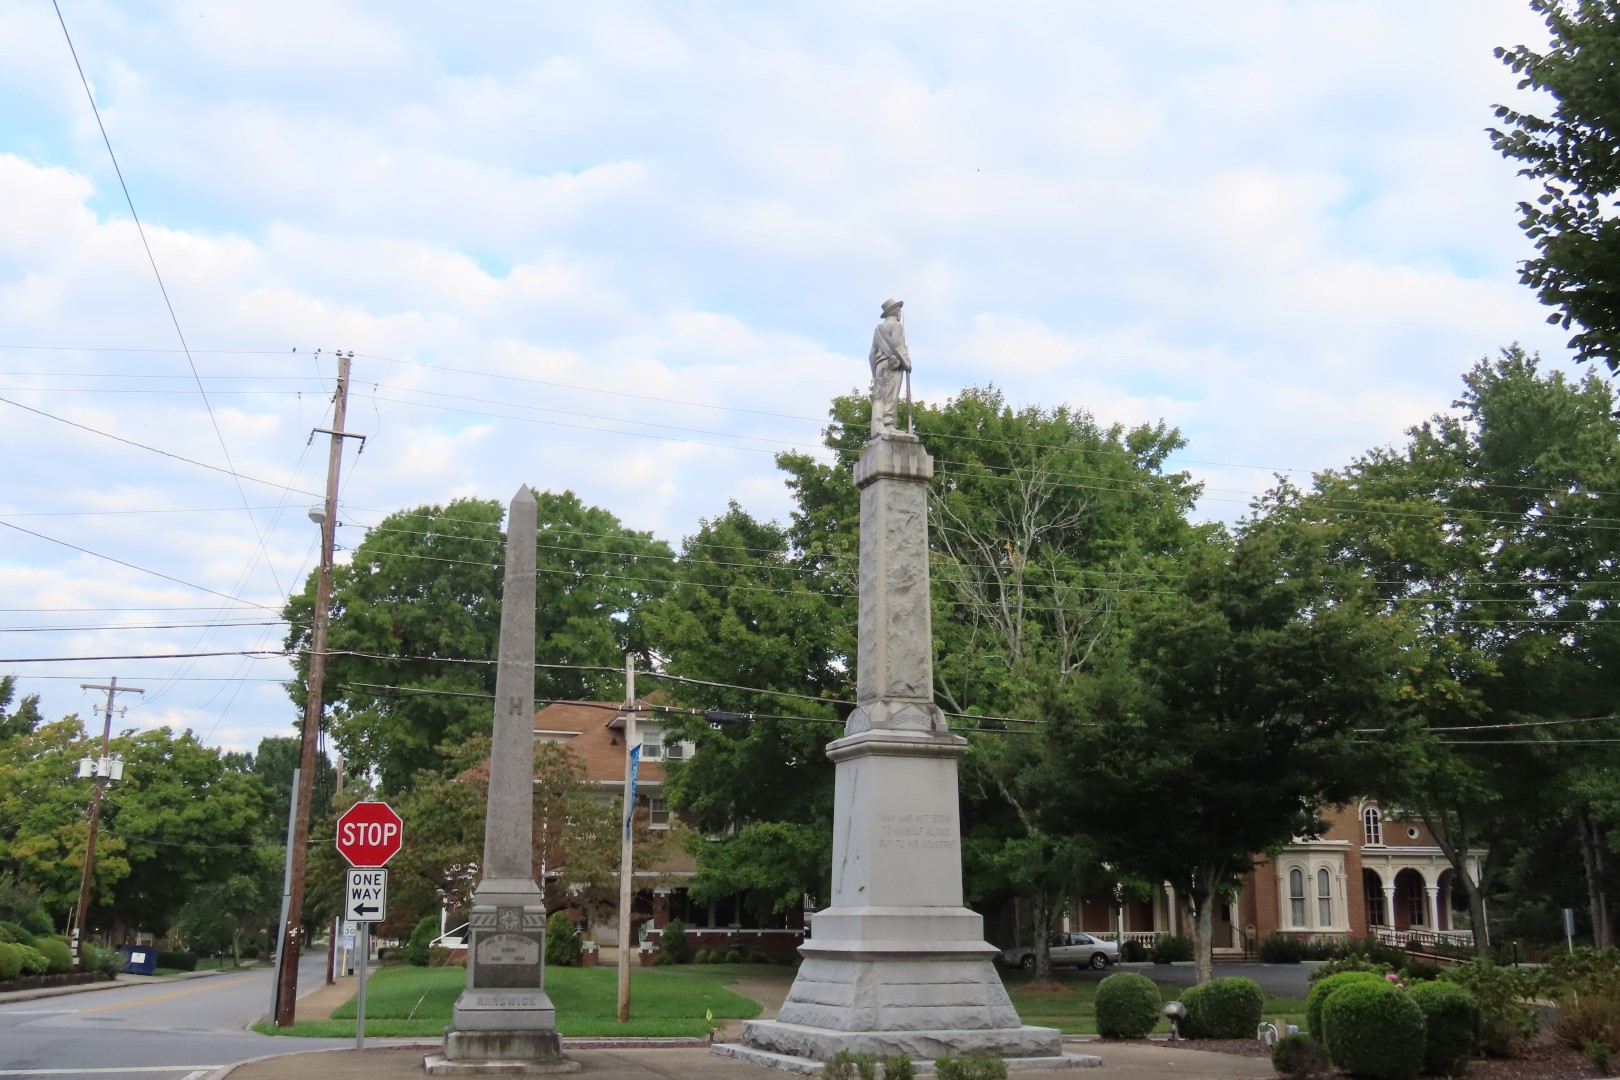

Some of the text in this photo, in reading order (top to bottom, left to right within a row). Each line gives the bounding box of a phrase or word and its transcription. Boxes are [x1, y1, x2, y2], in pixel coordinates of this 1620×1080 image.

[509, 696, 523, 716] H
[342, 822, 397, 846] STOP
[353, 874, 381, 886] ONE
[352, 888, 381, 900] WAY
